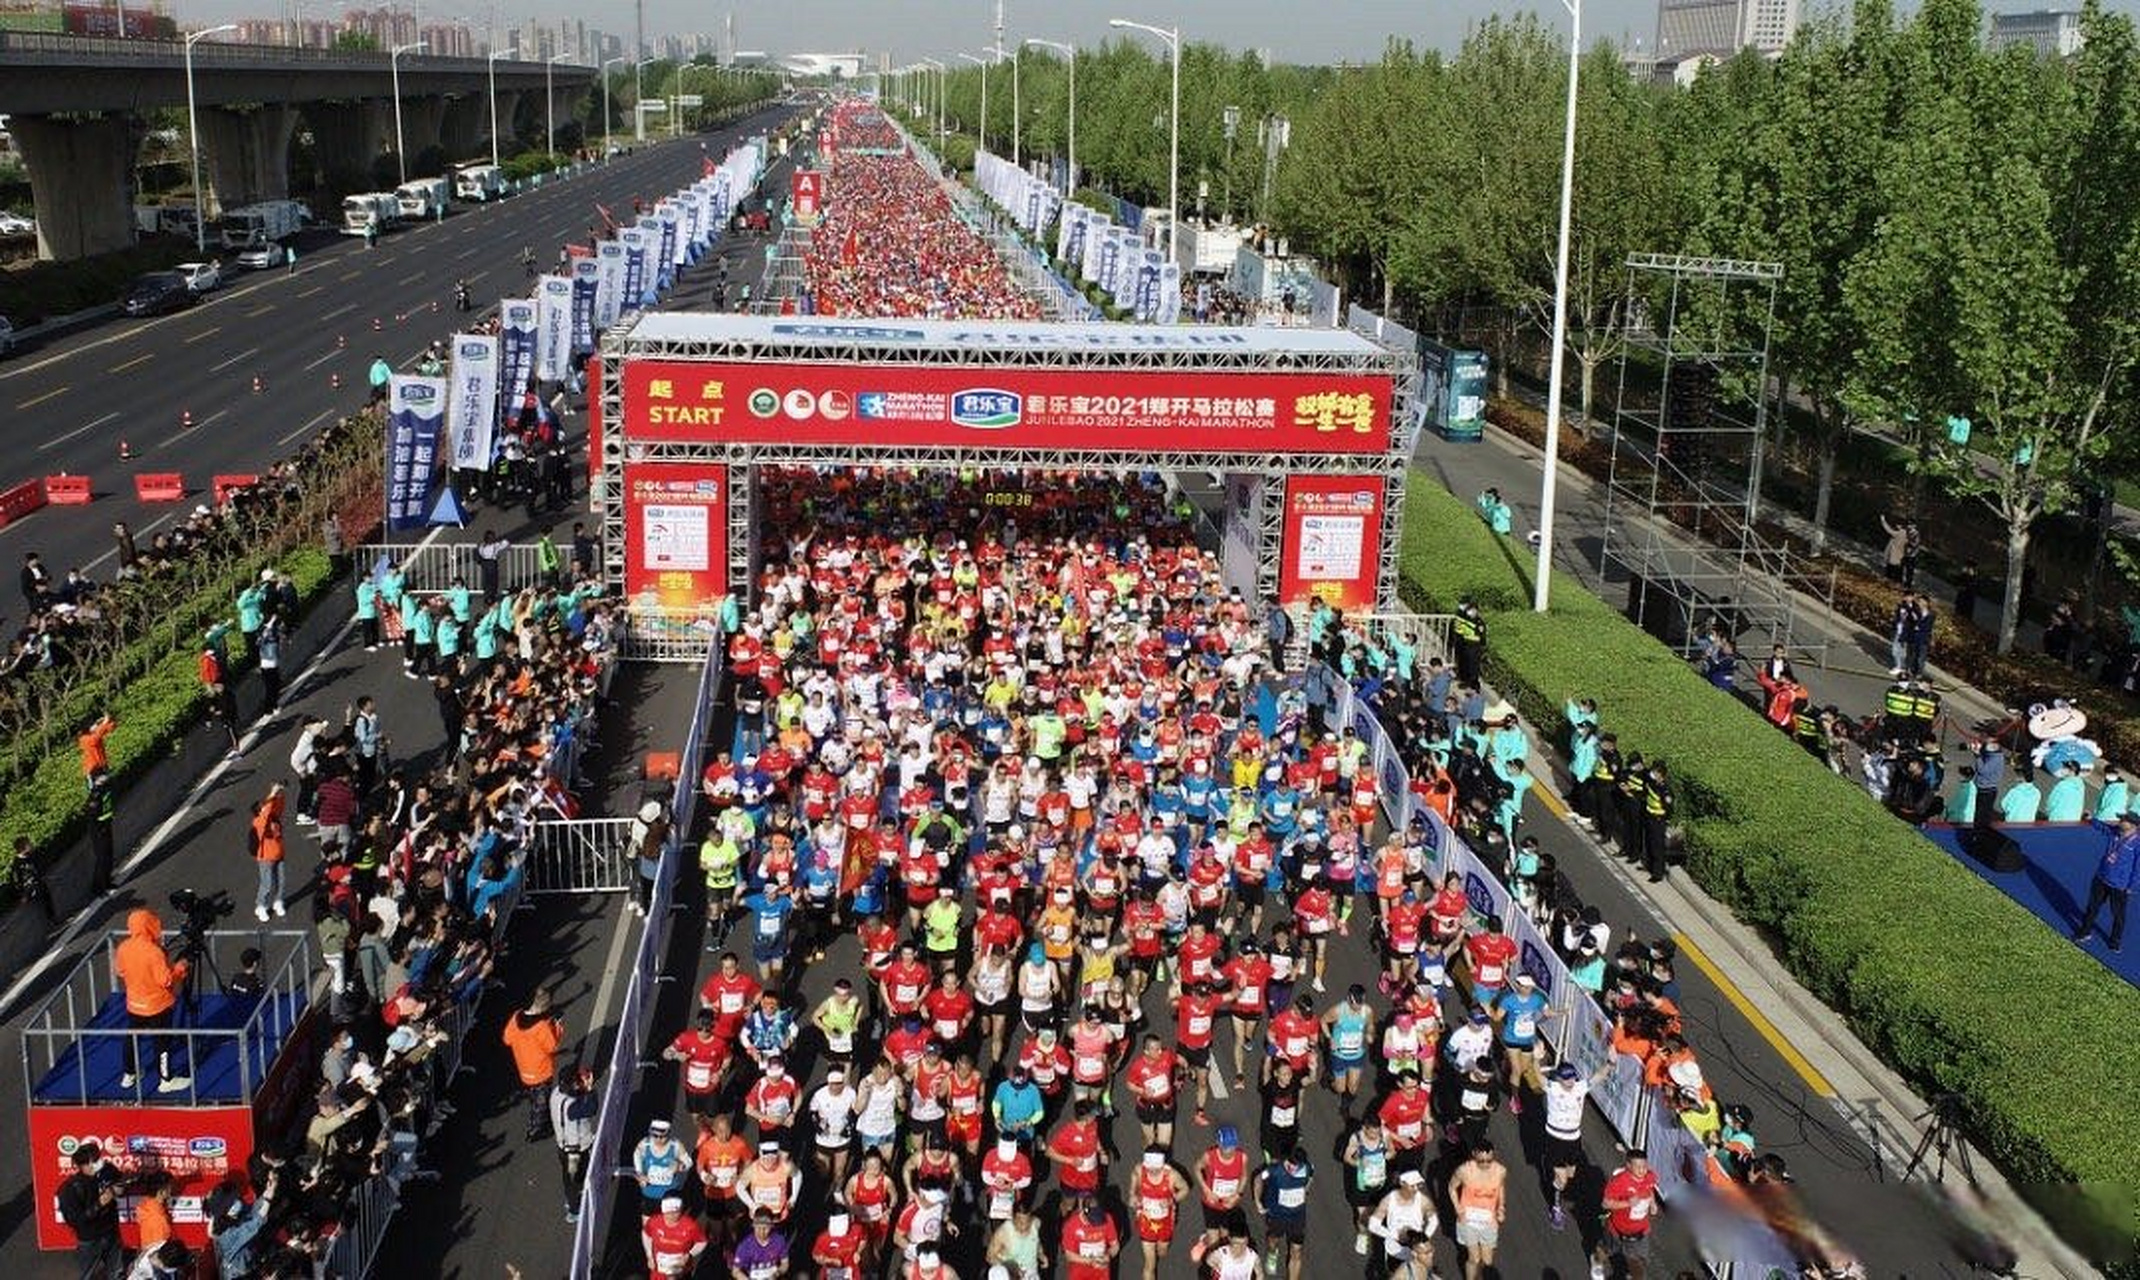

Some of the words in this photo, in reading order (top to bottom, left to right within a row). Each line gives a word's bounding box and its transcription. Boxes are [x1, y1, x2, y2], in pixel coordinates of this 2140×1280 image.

[800, 176, 814, 191] A
[962, 395, 1013, 414] 君乐宝
[649, 406, 724, 425] START
[1201, 417, 1275, 429] MARATHON
